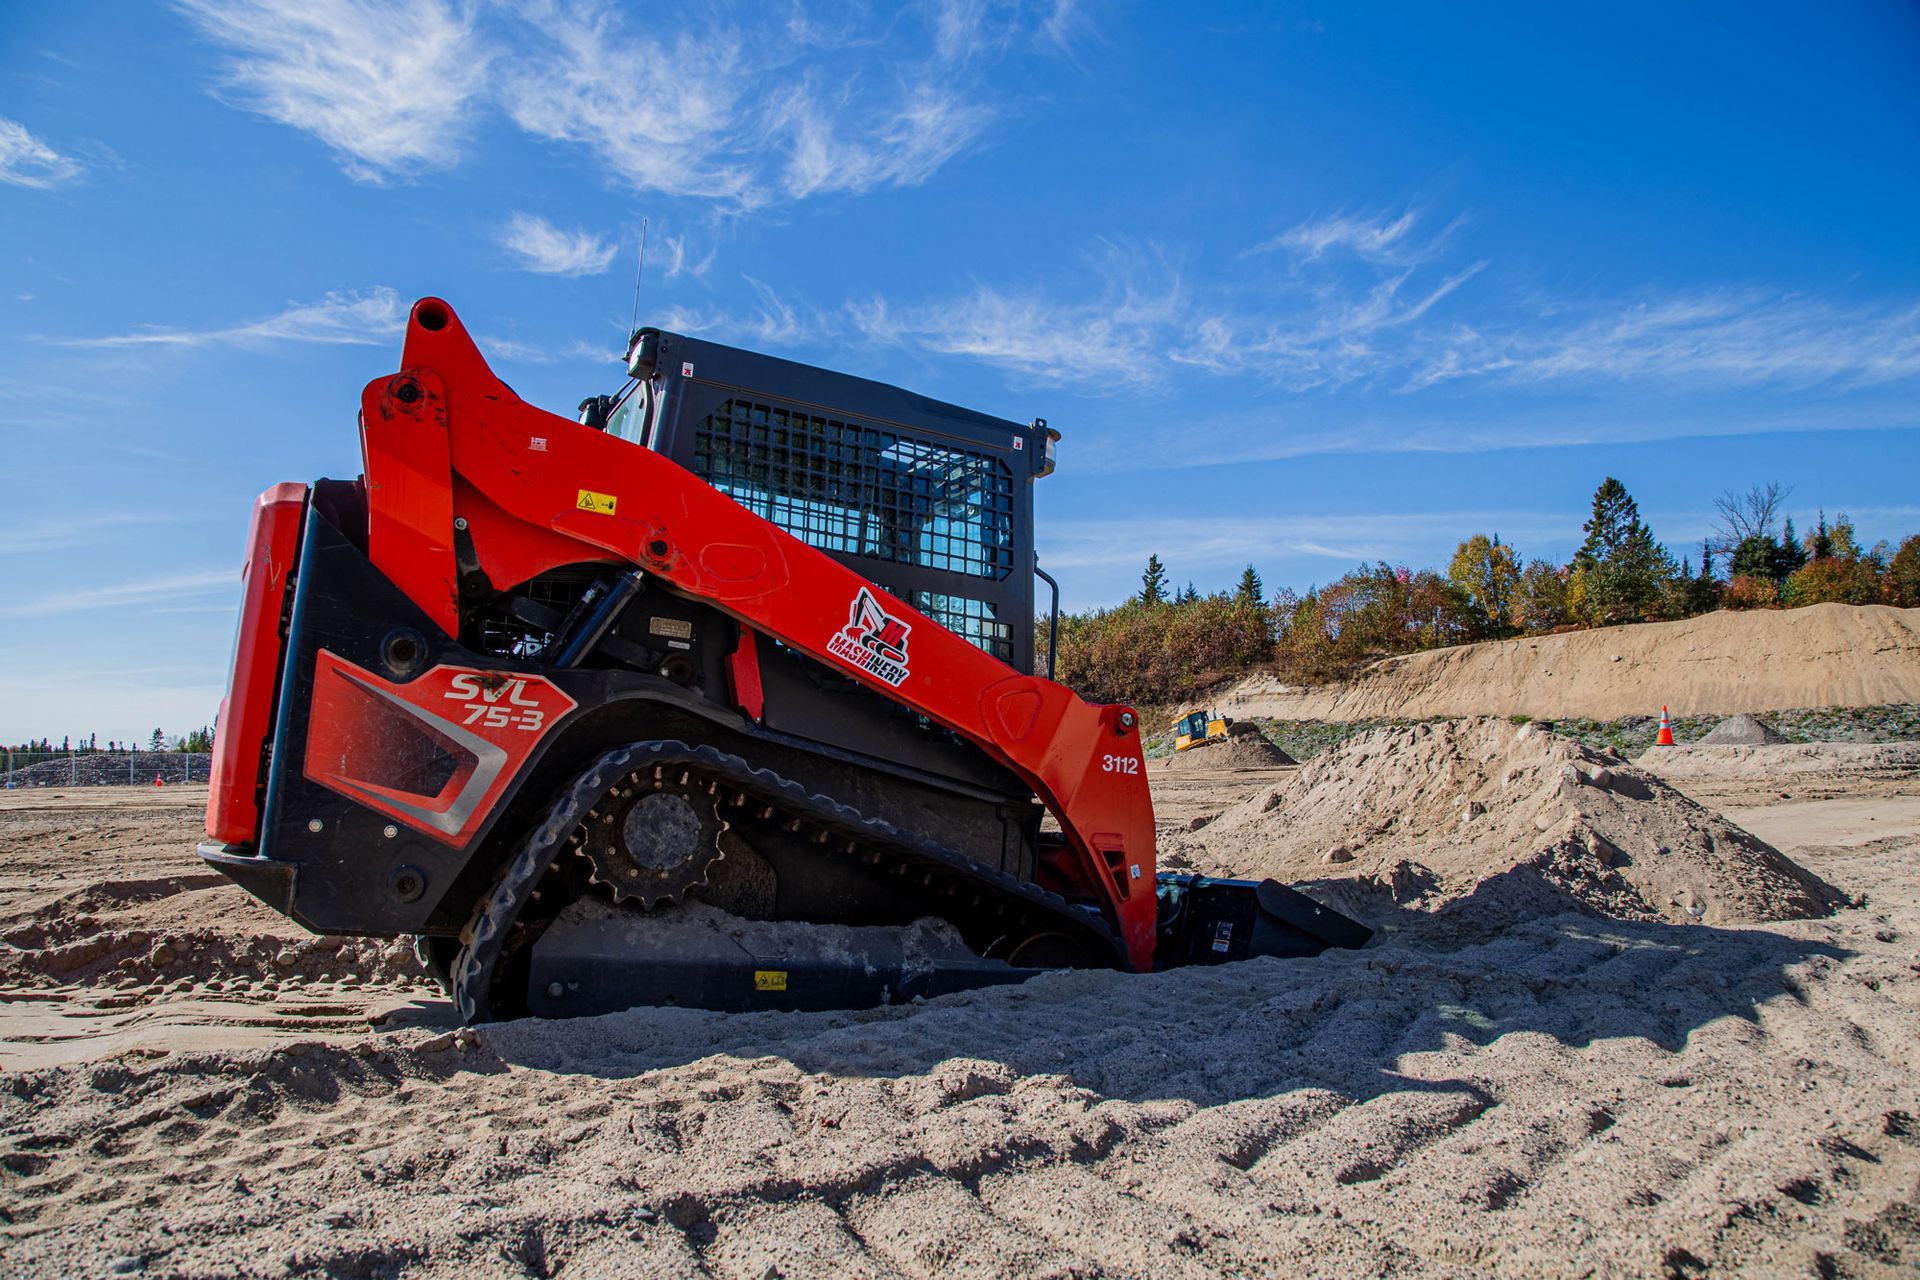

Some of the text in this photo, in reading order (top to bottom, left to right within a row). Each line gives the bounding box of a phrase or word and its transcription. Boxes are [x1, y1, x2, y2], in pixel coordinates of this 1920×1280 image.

[878, 619, 908, 647] M
[828, 635, 908, 685] MASHINERY
[443, 673, 539, 707] SVL
[462, 703, 544, 731] 75-3
[1102, 754, 1138, 775] 3112
